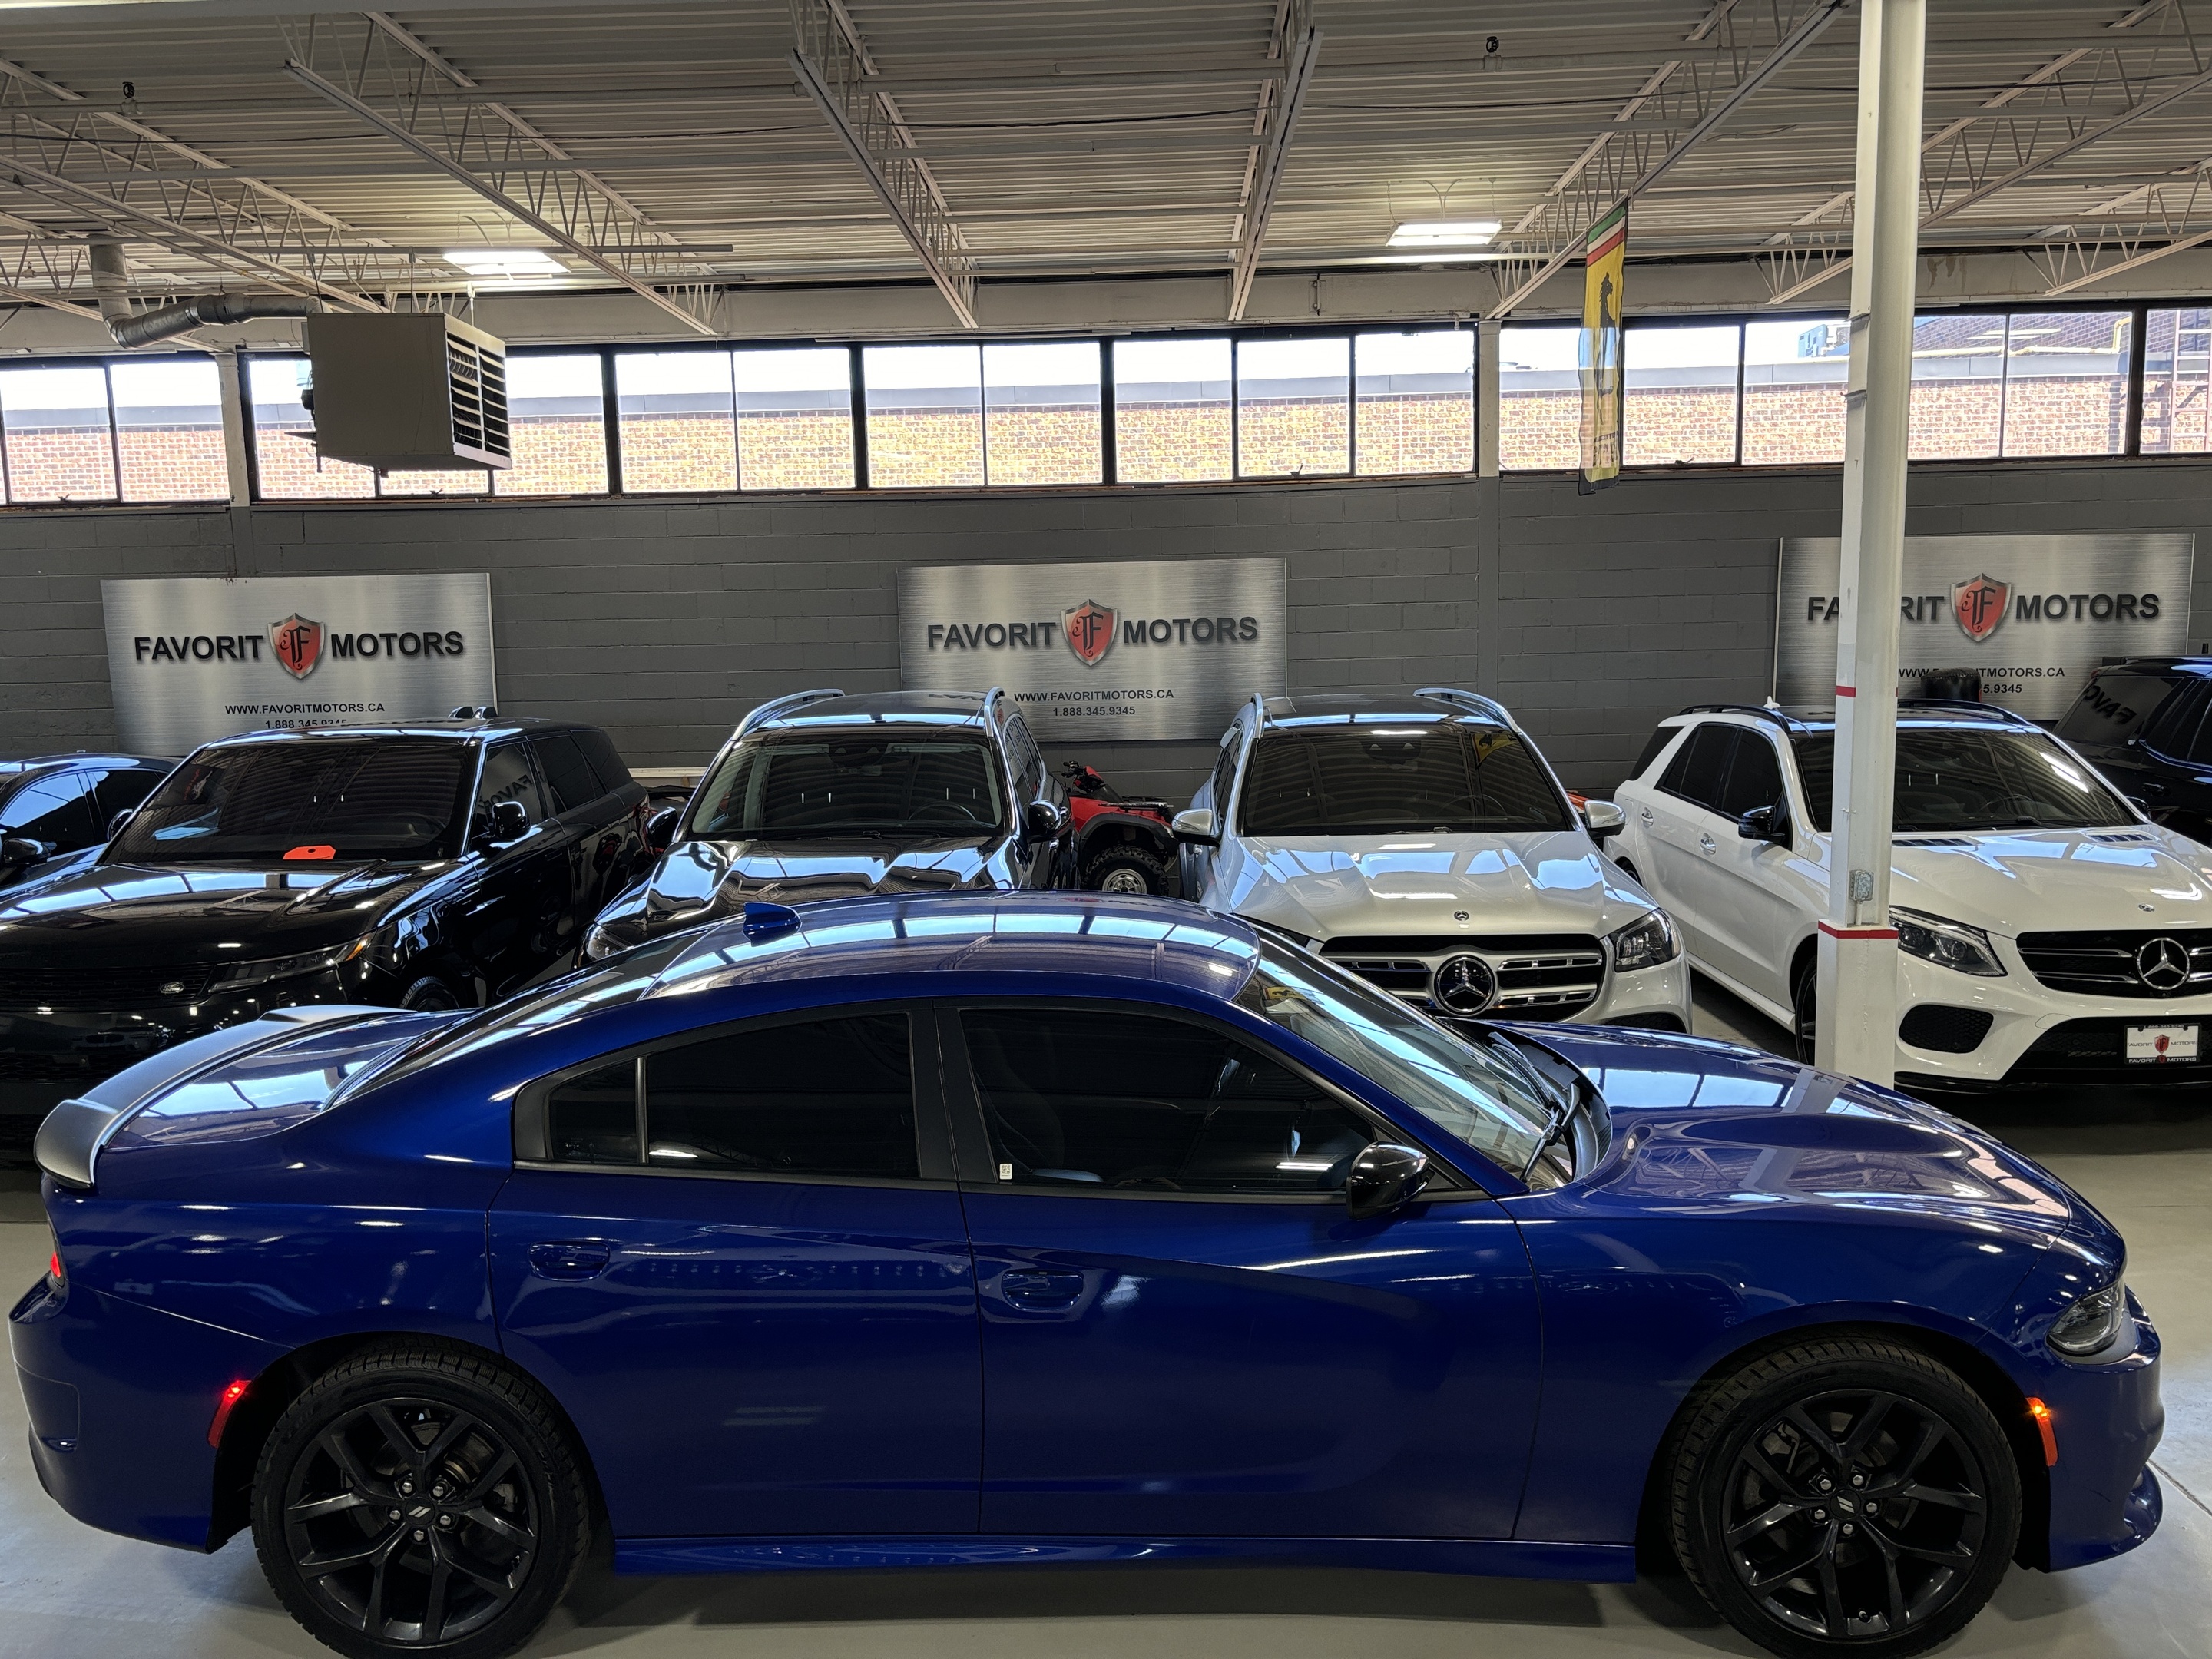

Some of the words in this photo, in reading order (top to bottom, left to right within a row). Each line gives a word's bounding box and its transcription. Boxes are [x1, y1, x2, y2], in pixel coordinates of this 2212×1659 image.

[1807, 595, 1945, 621] FARIT
[2015, 594, 2160, 620] MOTORS
[927, 622, 1056, 648] FAVORIT
[1124, 617, 1258, 644] MOTORS
[134, 635, 263, 661] FAVORIT
[331, 631, 465, 657] MOTORS
[1014, 690, 1174, 702] WWW.FAVORITMOTORS.CA
[225, 703, 385, 714] WWW.FAVORITMOTORS.CA
[1052, 706, 1136, 717] 1.888.345.9345
